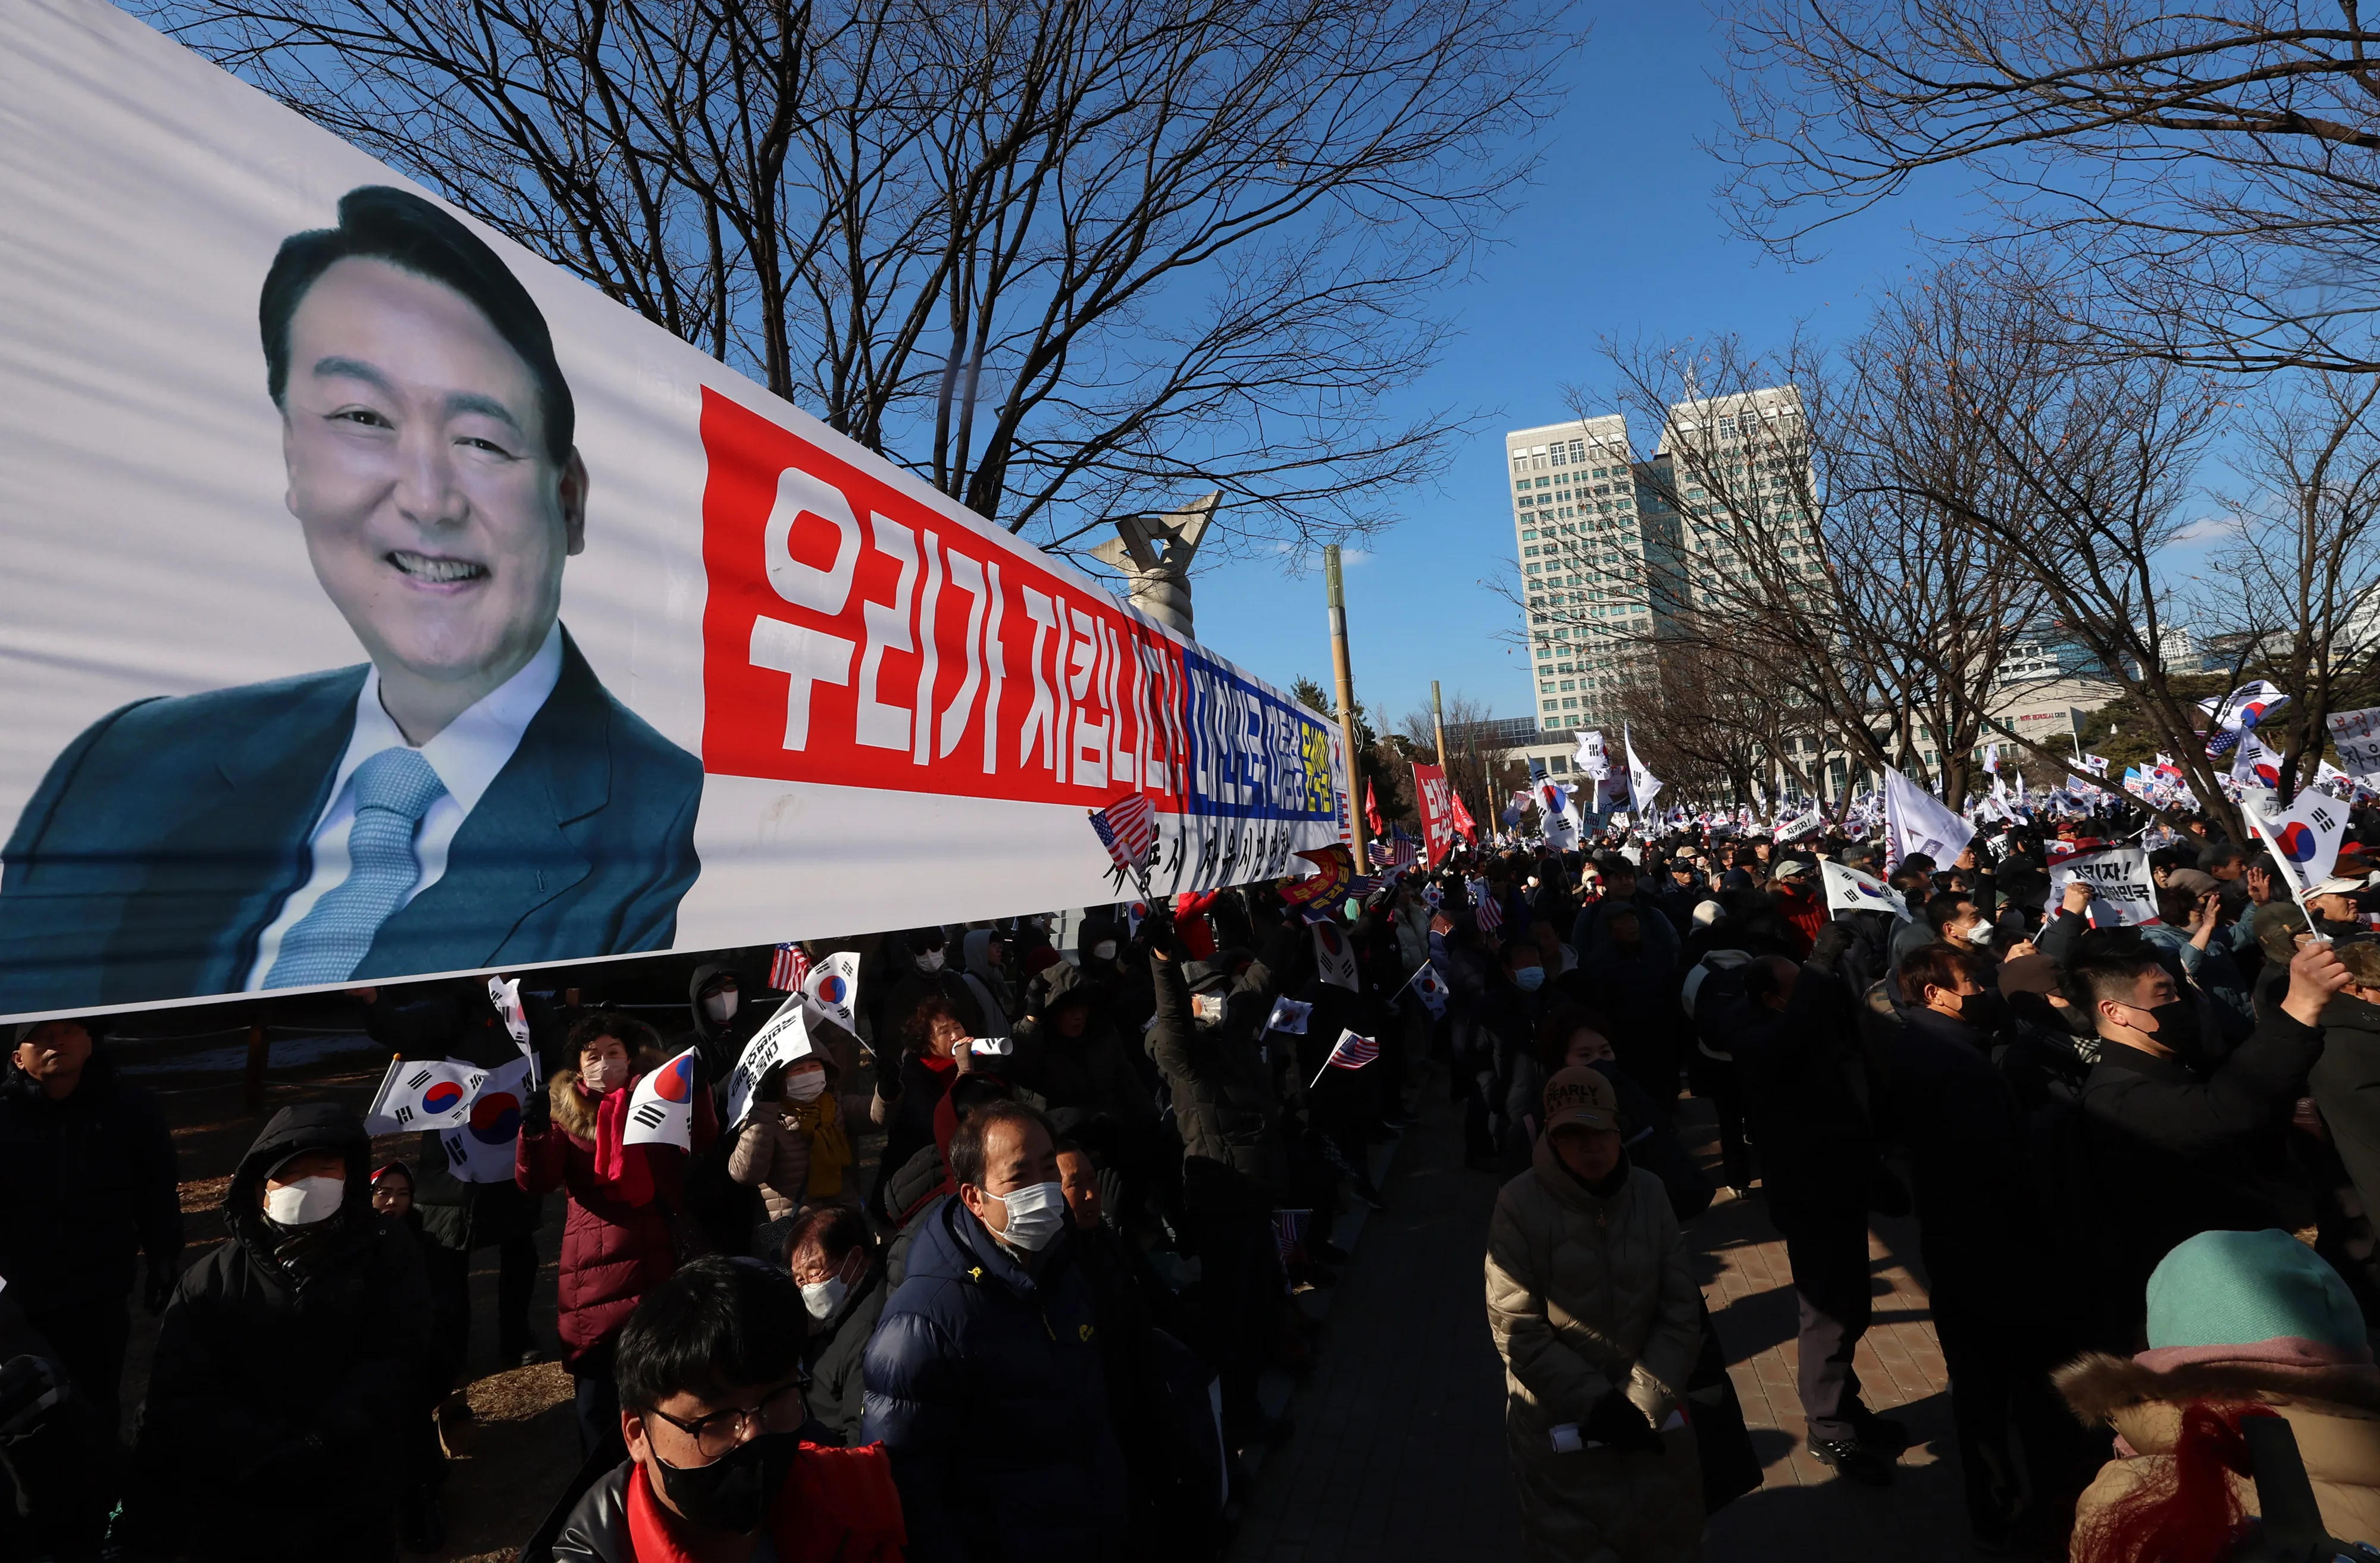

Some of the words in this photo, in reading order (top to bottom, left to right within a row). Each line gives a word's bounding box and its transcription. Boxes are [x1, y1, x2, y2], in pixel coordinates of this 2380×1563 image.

[749, 467, 1006, 773] 우리가
[1020, 584, 1184, 795] 지킵니다!
[1191, 667, 1266, 808] 대한민국
[1265, 704, 1304, 811] 대통령
[1302, 722, 1333, 812] 윤석열
[1786, 818, 1811, 835] 지키자!
[1199, 826, 1290, 885] 자유시민연합
[2067, 862, 2132, 882] 지키자!
[731, 1015, 797, 1098] 국민변호인단
[746, 1040, 779, 1092] 대통령
[1547, 1084, 1598, 1106] PEARLY
[1549, 1095, 1599, 1113] GATES
